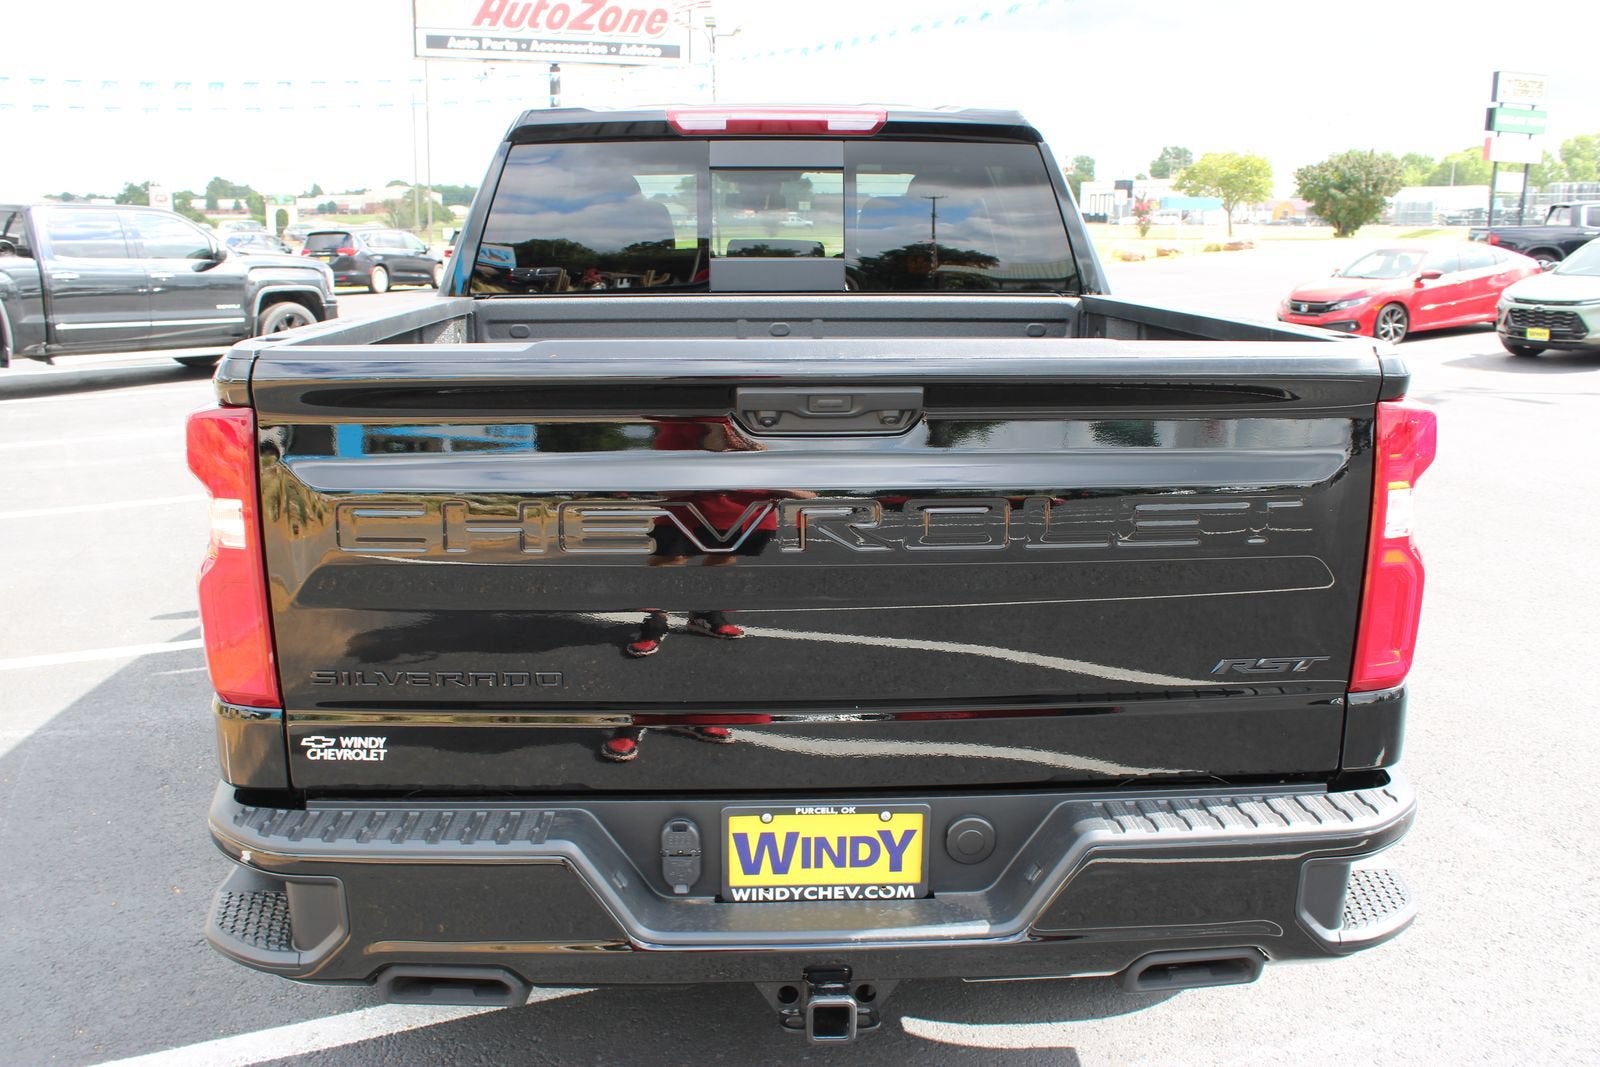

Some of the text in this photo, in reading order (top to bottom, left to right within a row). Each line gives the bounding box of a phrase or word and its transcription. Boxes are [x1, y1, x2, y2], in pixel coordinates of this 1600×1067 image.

[471, 0, 669, 34] AutoZone
[447, 36, 480, 50] Auto
[481, 38, 518, 51] Parts
[335, 499, 1314, 554] CHEVROLET
[1210, 656, 1331, 676] RST
[310, 670, 564, 688] SILVERADO
[339, 736, 387, 748] WINDY
[306, 748, 388, 761] CHEVROLET
[795, 806, 856, 815] PURCELL, OK
[731, 885, 915, 901] WINDYCHEV.COM
